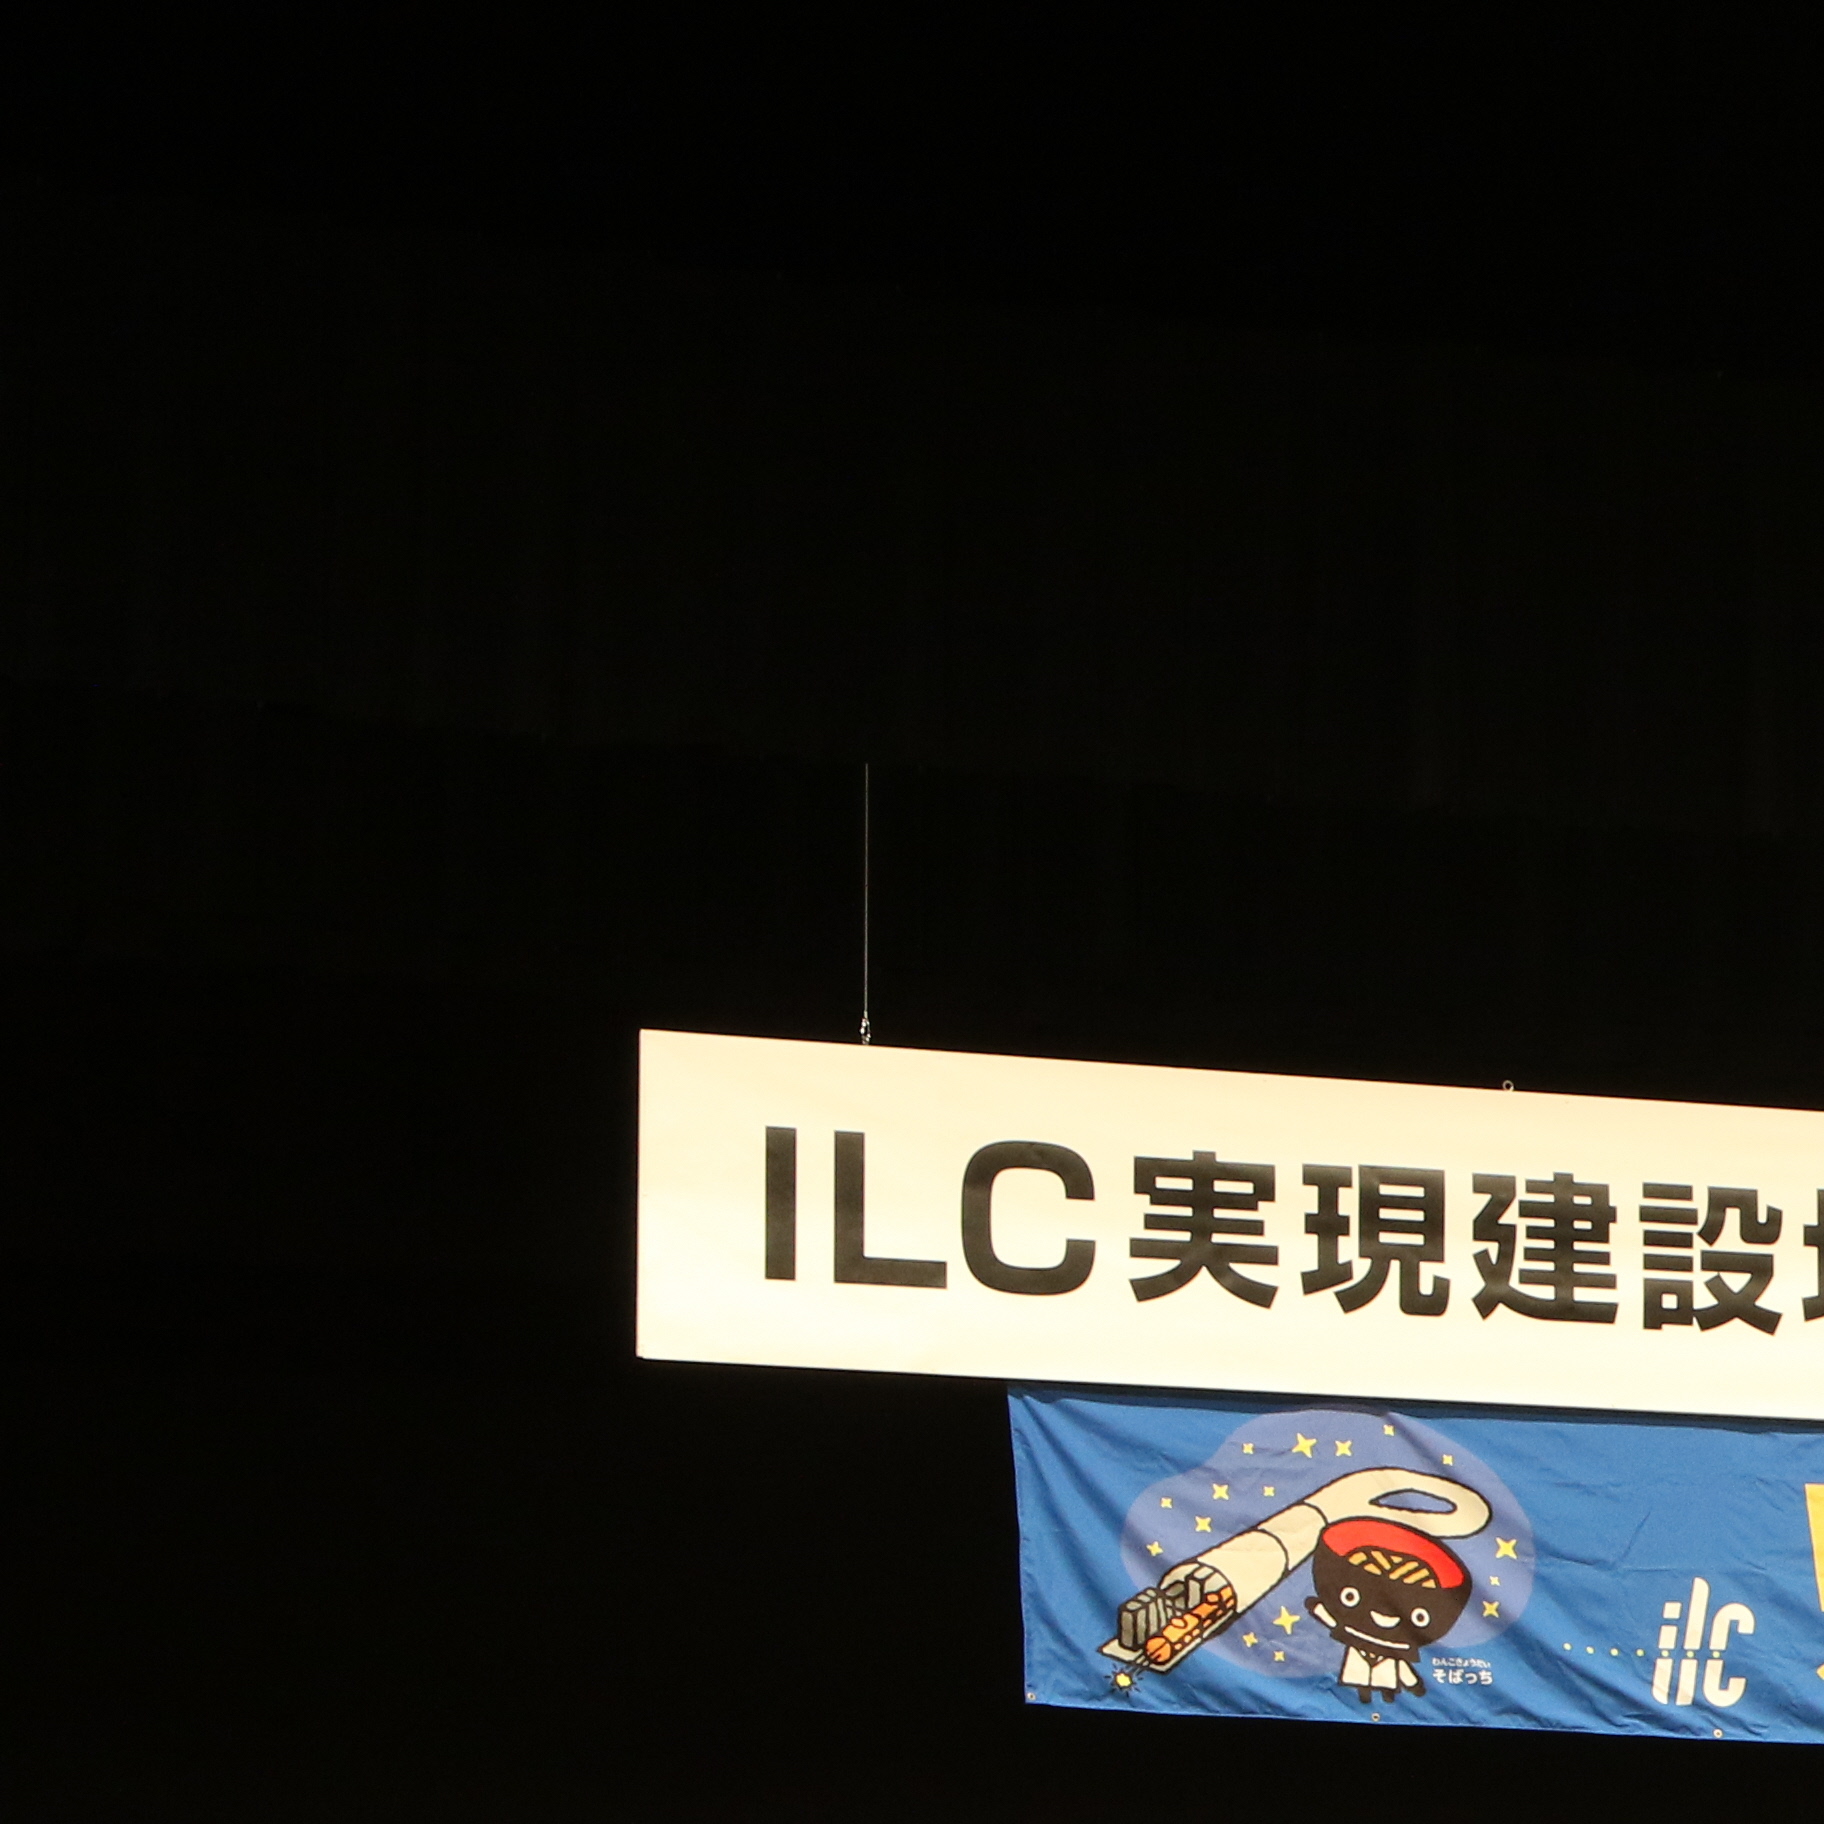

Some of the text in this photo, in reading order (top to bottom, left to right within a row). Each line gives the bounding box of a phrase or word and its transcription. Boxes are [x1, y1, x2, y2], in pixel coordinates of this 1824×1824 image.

[1432, 1669, 1493, 1685] そばっち
[1651, 1576, 1757, 1708] ilc
